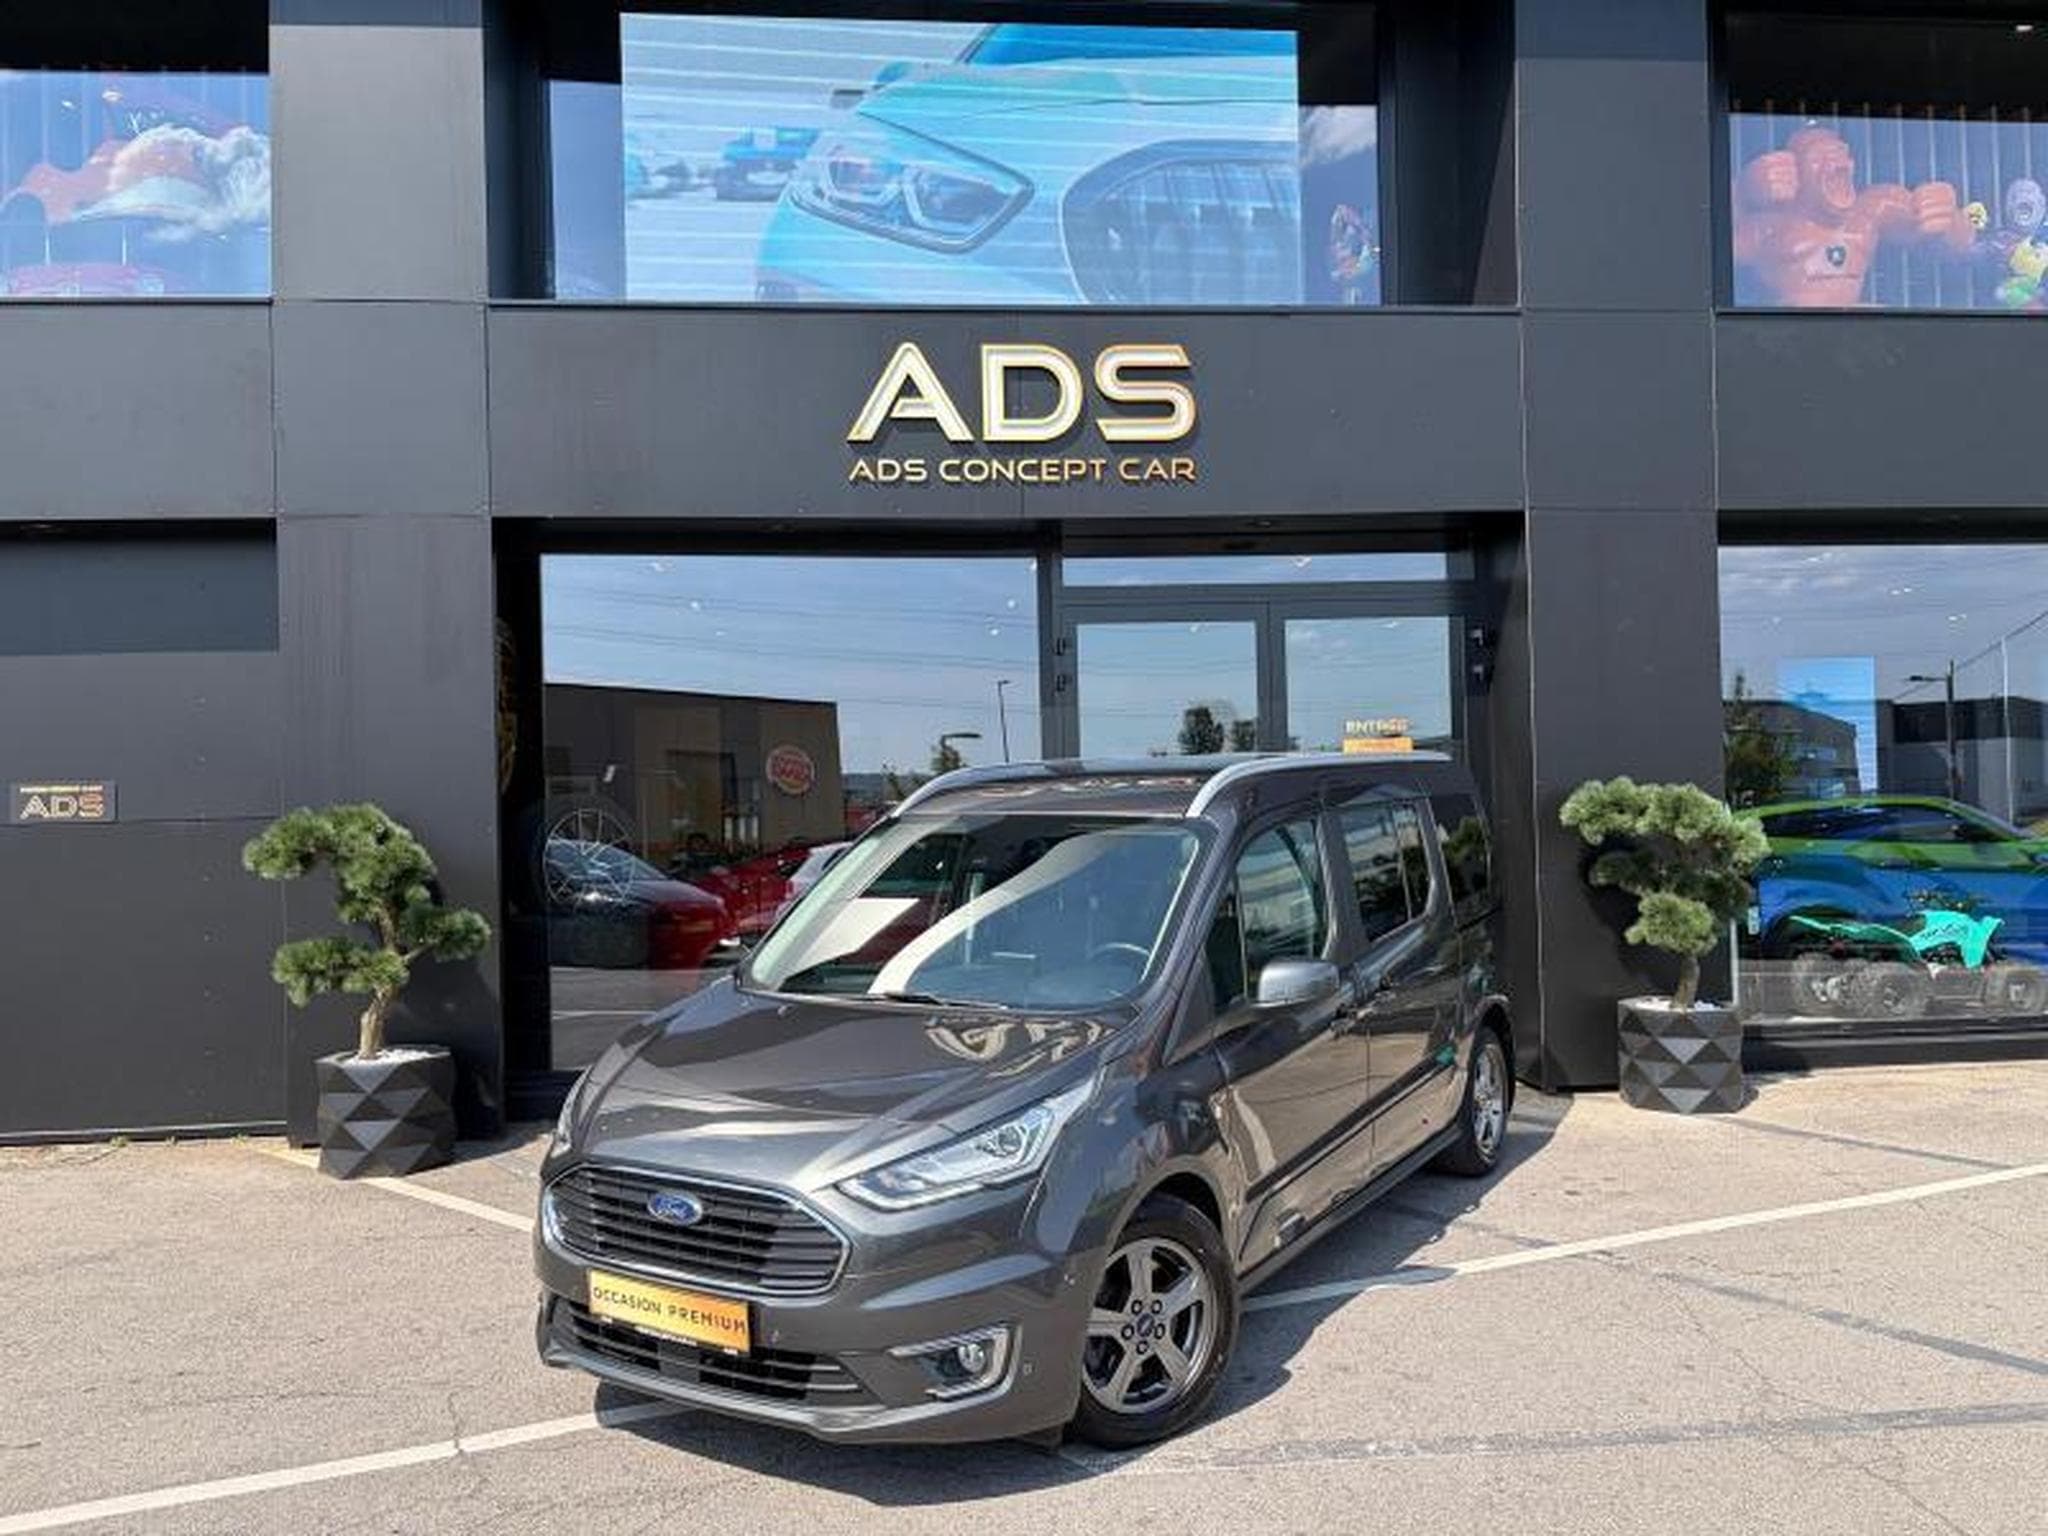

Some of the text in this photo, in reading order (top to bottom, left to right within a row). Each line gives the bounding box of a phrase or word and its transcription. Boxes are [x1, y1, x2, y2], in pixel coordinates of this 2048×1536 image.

[847, 341, 1196, 442] ADS
[848, 458, 1196, 482] ADS CONCEPT CAR
[20, 795, 104, 819] ADS
[592, 1286, 746, 1335] OCCASION PREMIUM
